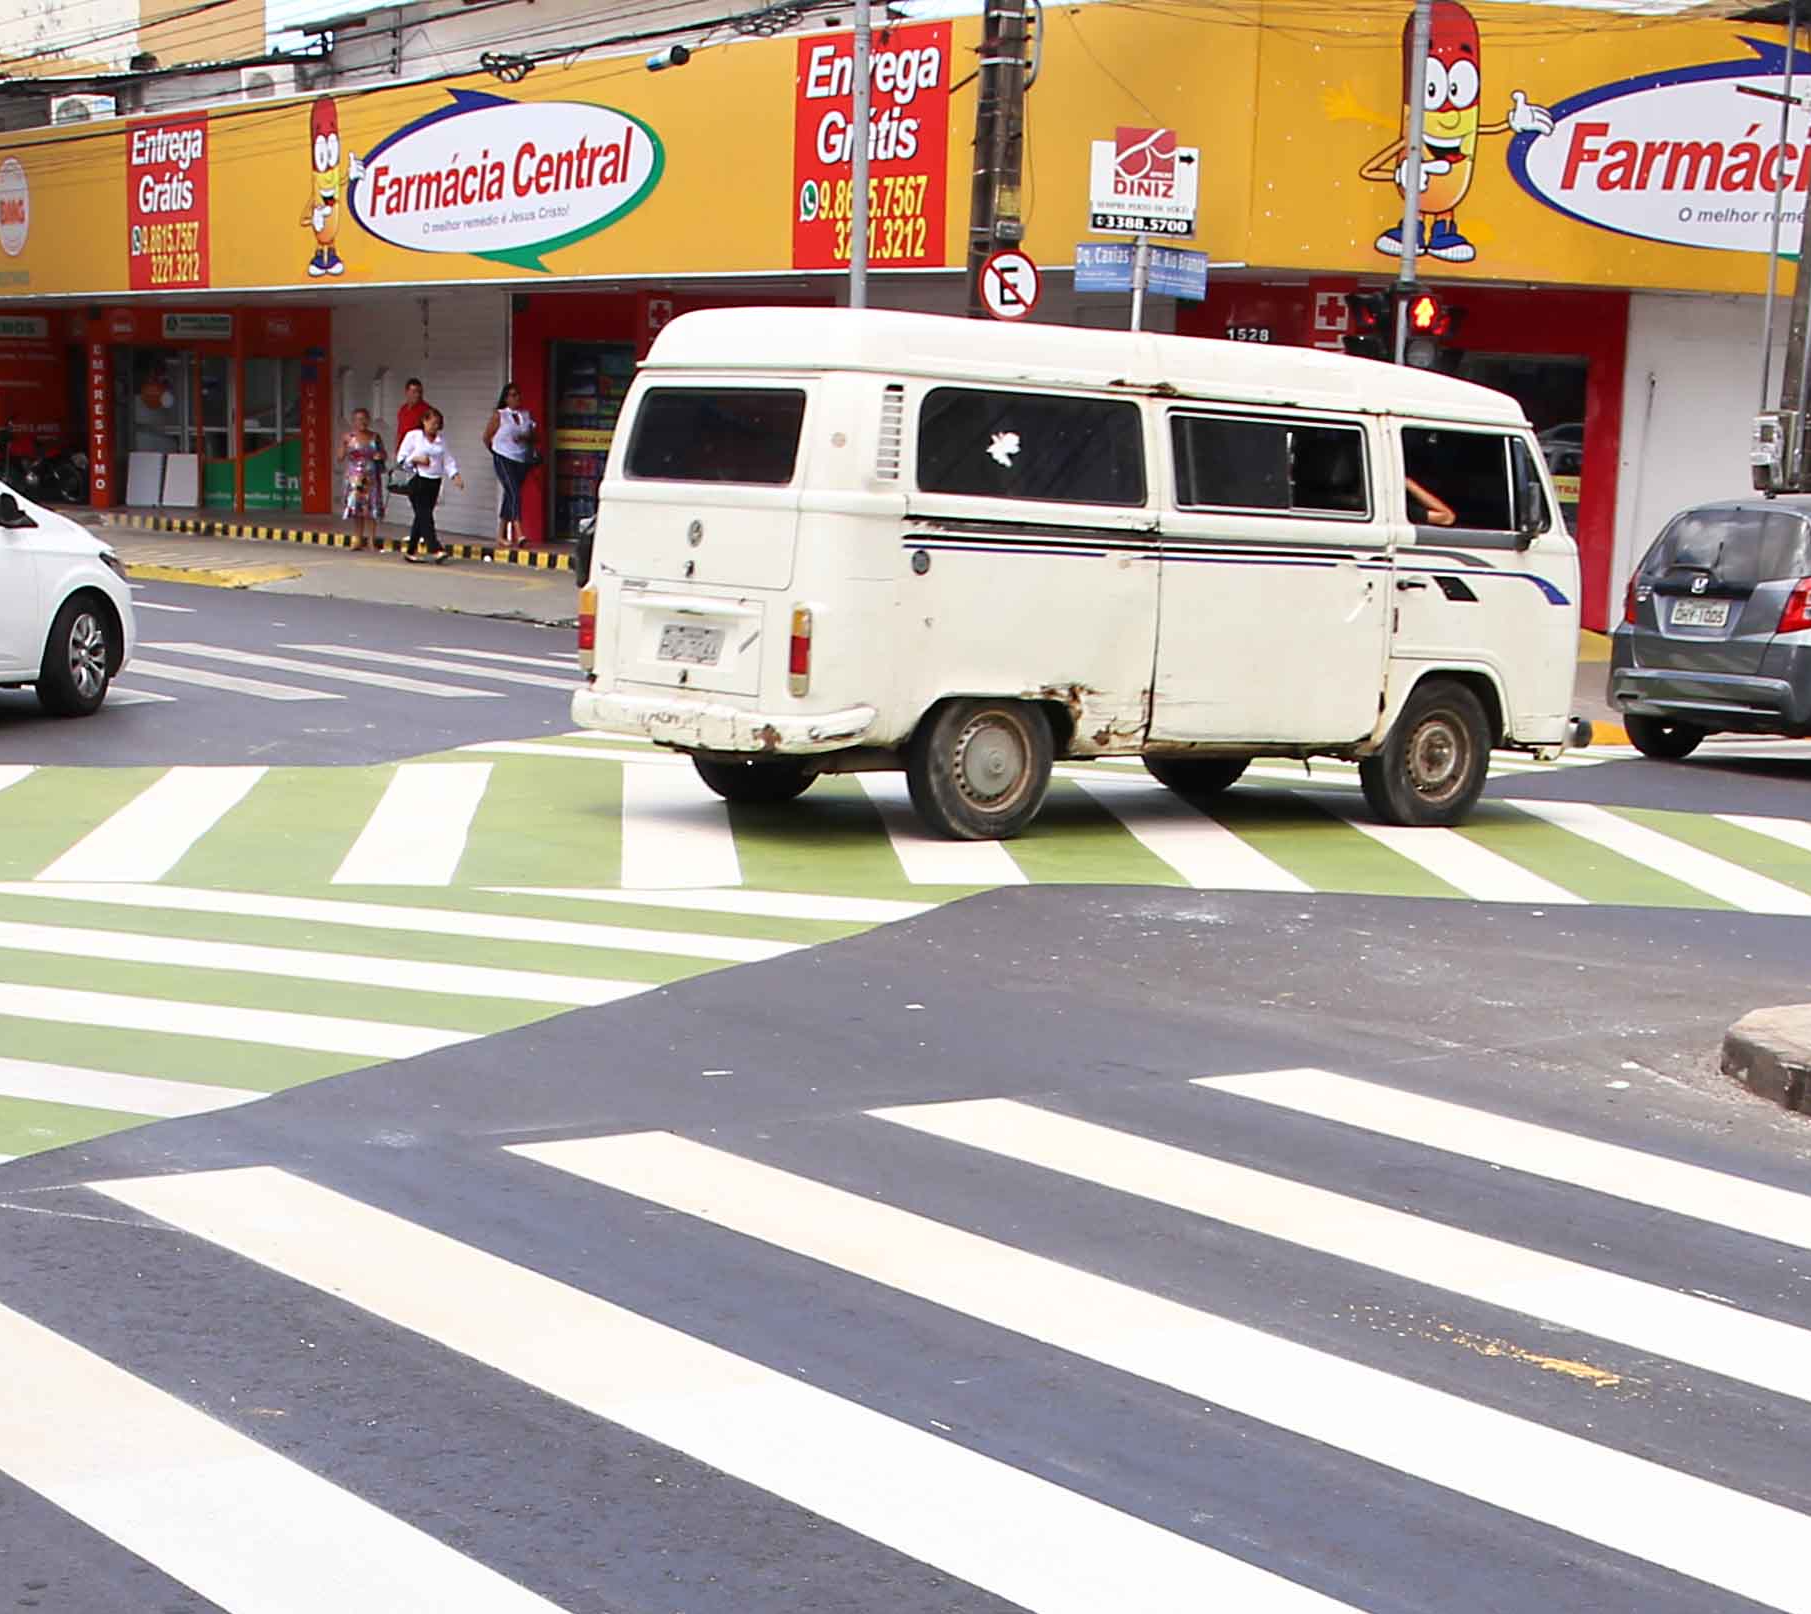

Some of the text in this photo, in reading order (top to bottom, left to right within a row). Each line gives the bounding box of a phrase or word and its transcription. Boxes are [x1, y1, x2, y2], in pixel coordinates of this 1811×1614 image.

[132, 128, 203, 169] Entrega
[370, 126, 633, 217] Farmácia Central
[139, 172, 194, 212] Grátis
[1114, 180, 1174, 198] DINIZ
[431, 219, 461, 233] melhor
[509, 207, 535, 222] Jesus
[1106, 216, 1188, 233] 3388.5700
[1678, 208, 1692, 222] O
[1697, 207, 1758, 223] melhor
[1227, 328, 1269, 342] 1528
